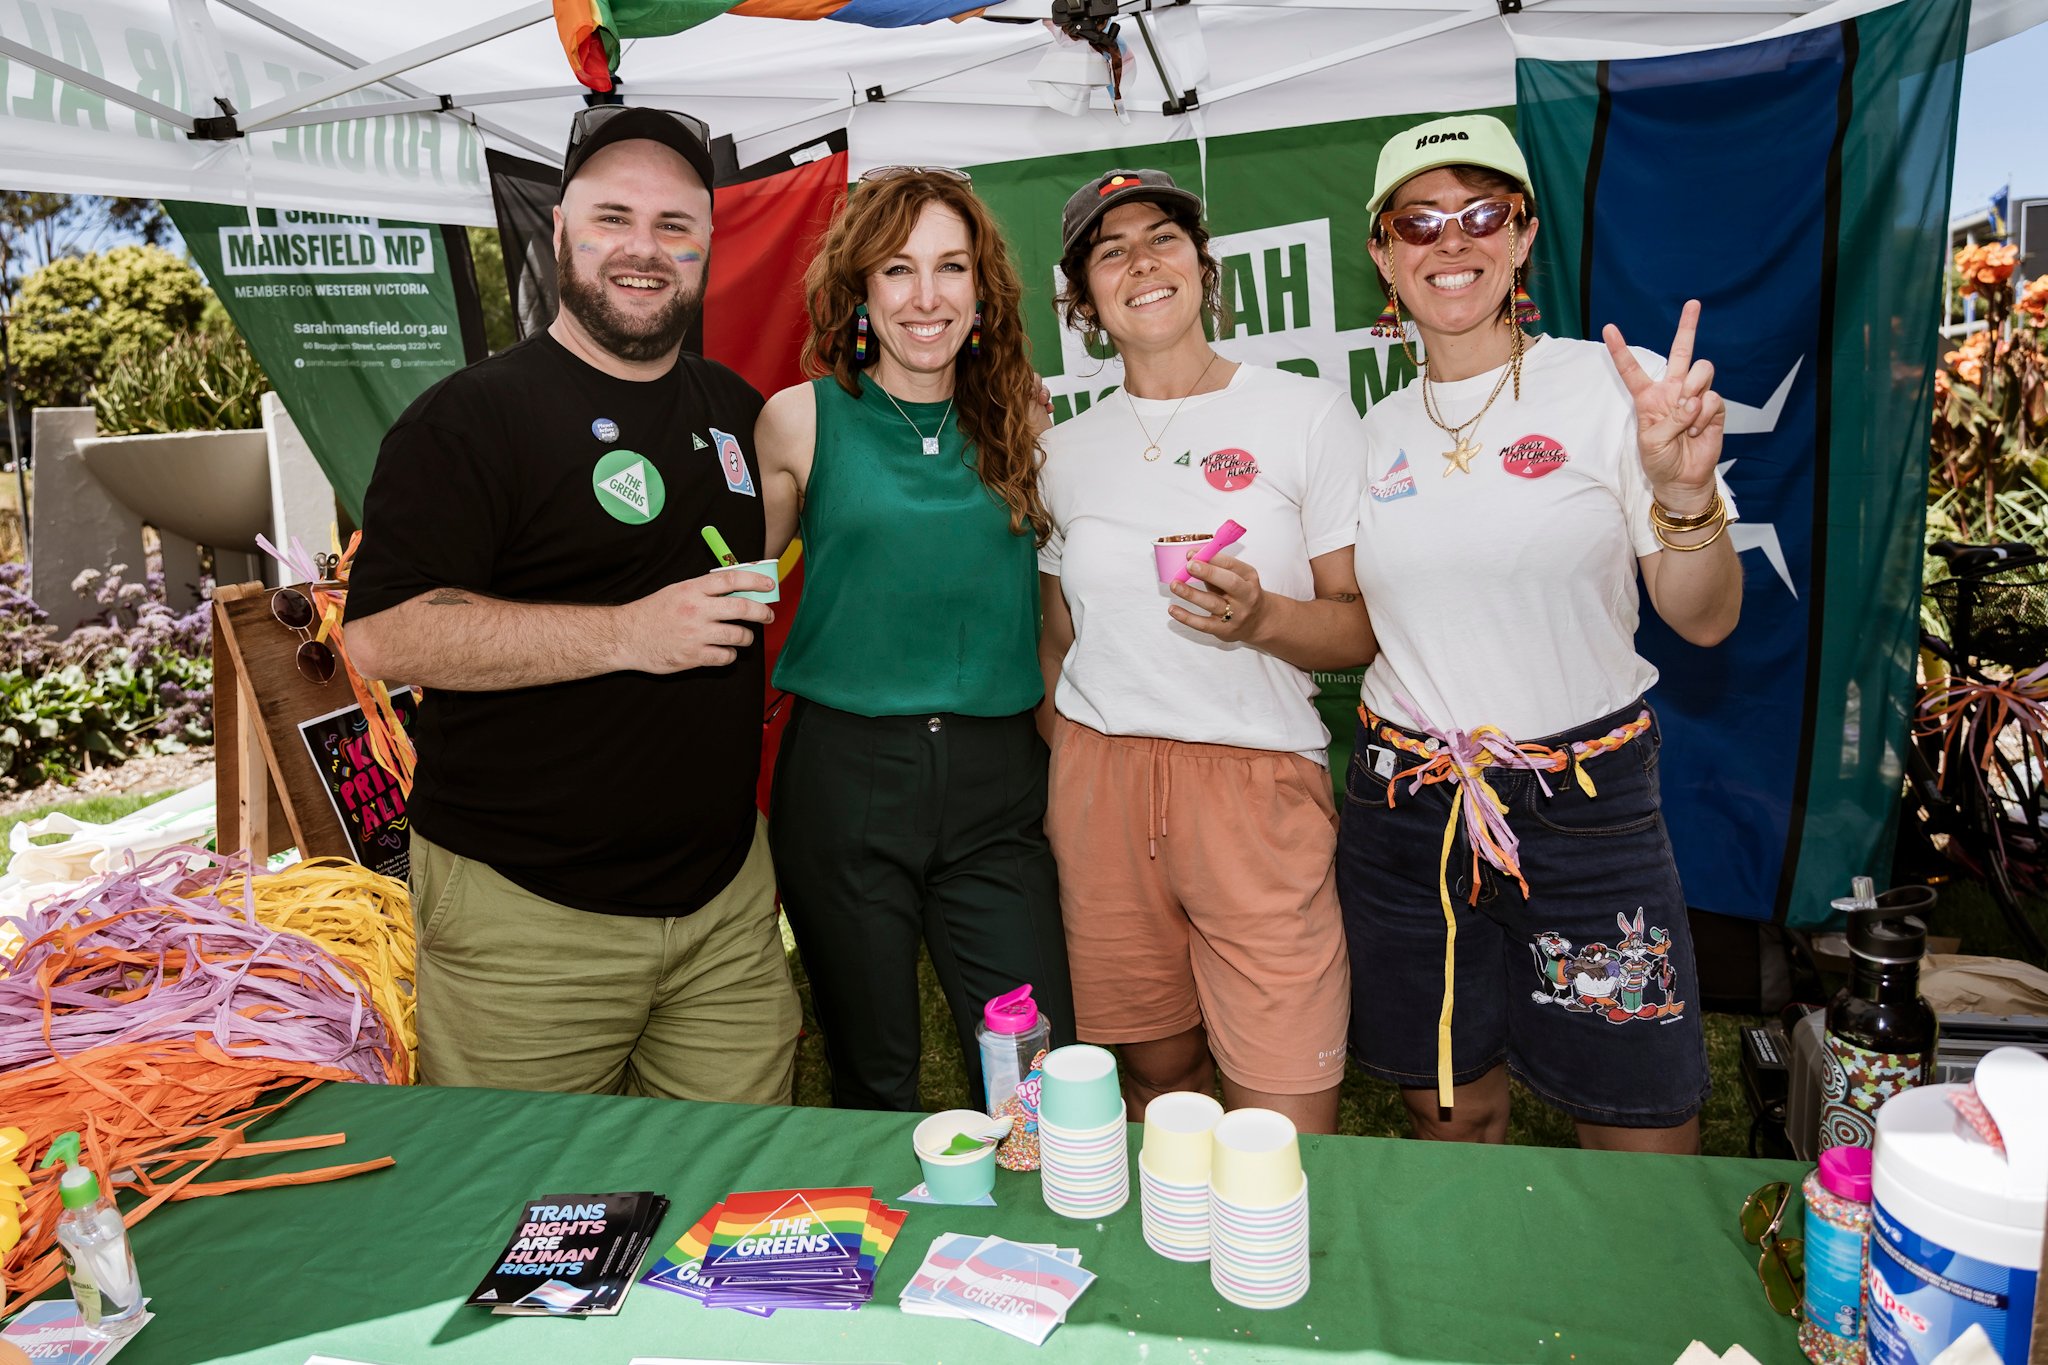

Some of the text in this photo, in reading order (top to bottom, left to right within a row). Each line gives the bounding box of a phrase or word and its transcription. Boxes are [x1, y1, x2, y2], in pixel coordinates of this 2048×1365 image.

[1415, 131, 1470, 150] HOMO
[228, 233, 425, 267] MANSFIELD MP
[234, 283, 429, 298] MEMBER FOR WESTERN VICTORIA
[293, 320, 448, 338] sarahmansfield.org.au
[376, 342, 406, 352] Geelong
[408, 342, 426, 350] 3220
[428, 342, 441, 350] VIC
[1499, 445, 1516, 456] MY
[1509, 452, 1526, 463] MY
[1199, 454, 1213, 467] MY
[1209, 461, 1223, 473] MY
[624, 472, 643, 491] THE
[1369, 479, 1411, 499] GREENS
[609, 478, 646, 507] GREENS
[340, 765, 399, 811] PRI
[529, 1203, 607, 1223] TRANS
[519, 1220, 608, 1237] RIGHTS
[769, 1217, 812, 1237] THE
[511, 1235, 564, 1251] ARE
[736, 1233, 831, 1257] GREENS
[504, 1246, 599, 1264] HUMAN
[495, 1261, 585, 1276] RIGHTS
[962, 1283, 1035, 1321] GREENS
[20, 1343, 70, 1358] REENS
